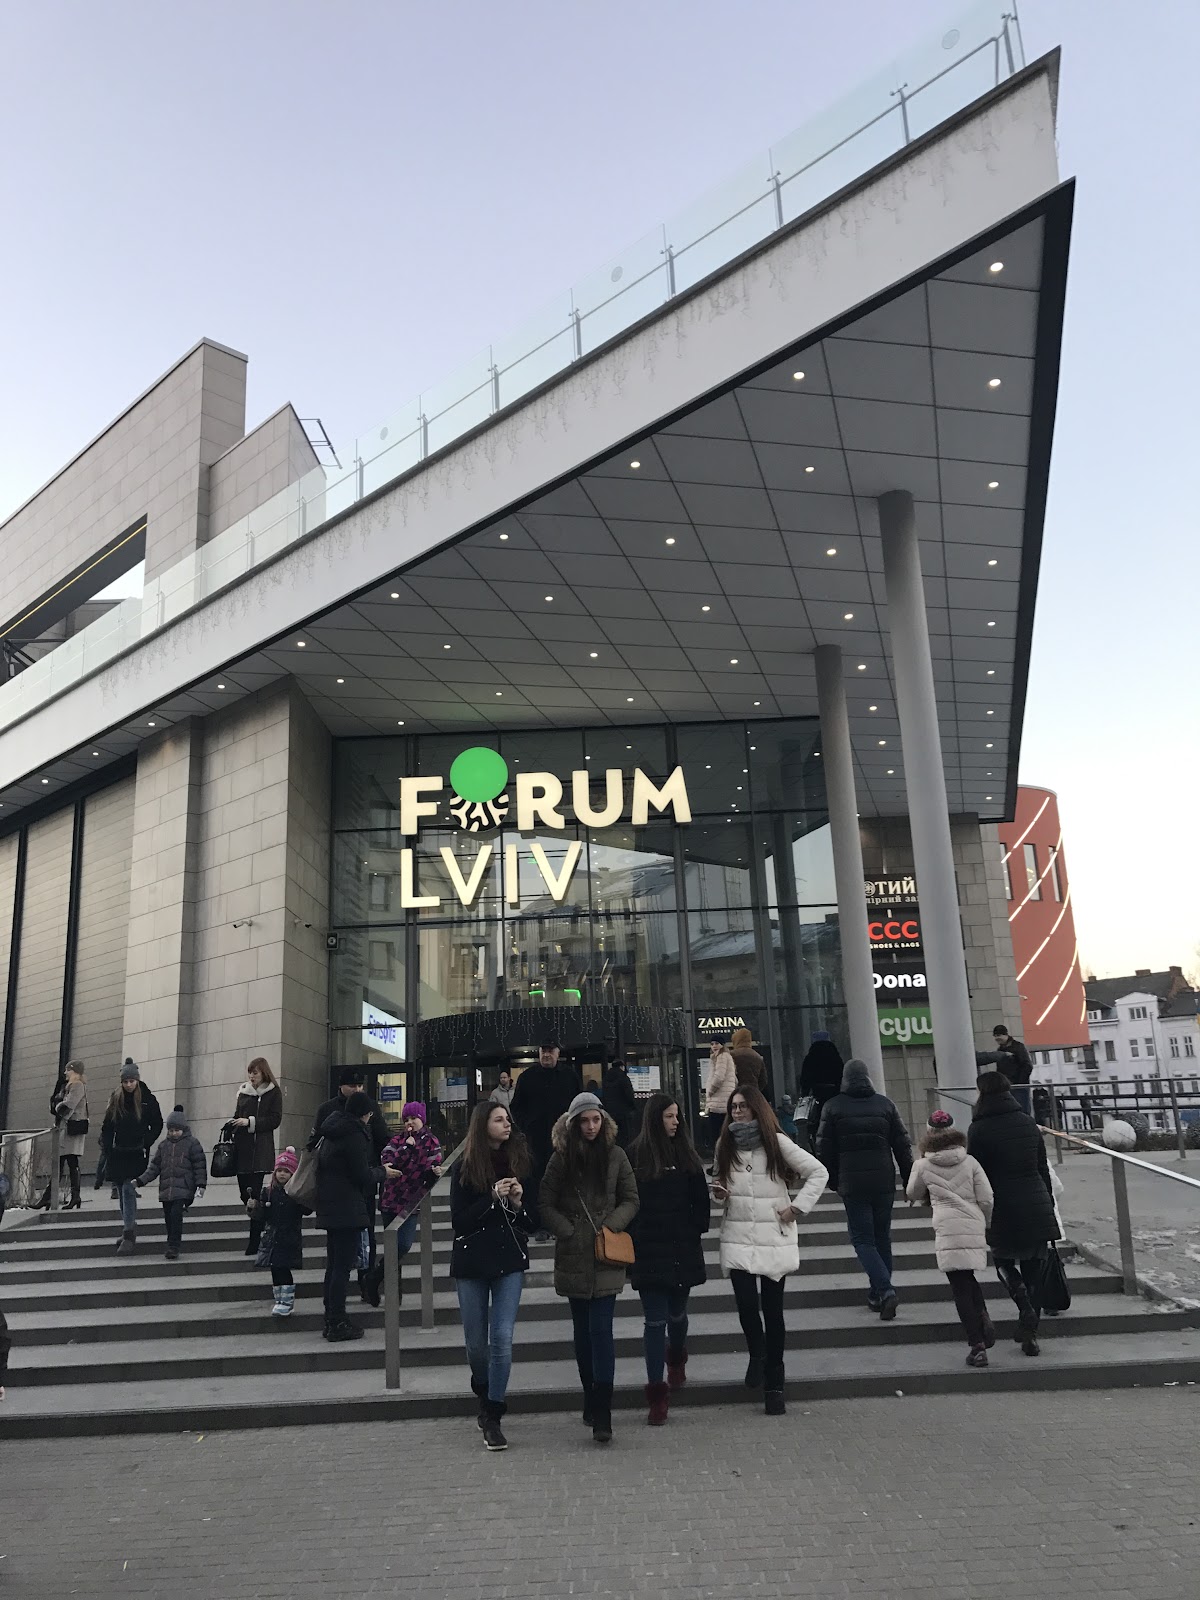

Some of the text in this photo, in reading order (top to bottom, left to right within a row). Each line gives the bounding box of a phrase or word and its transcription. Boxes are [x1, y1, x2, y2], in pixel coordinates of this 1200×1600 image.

[400, 747, 692, 836] FORUM
[400, 841, 583, 908] LVIV
[868, 920, 919, 940] CCC
[698, 1016, 746, 1028] ZARINA
